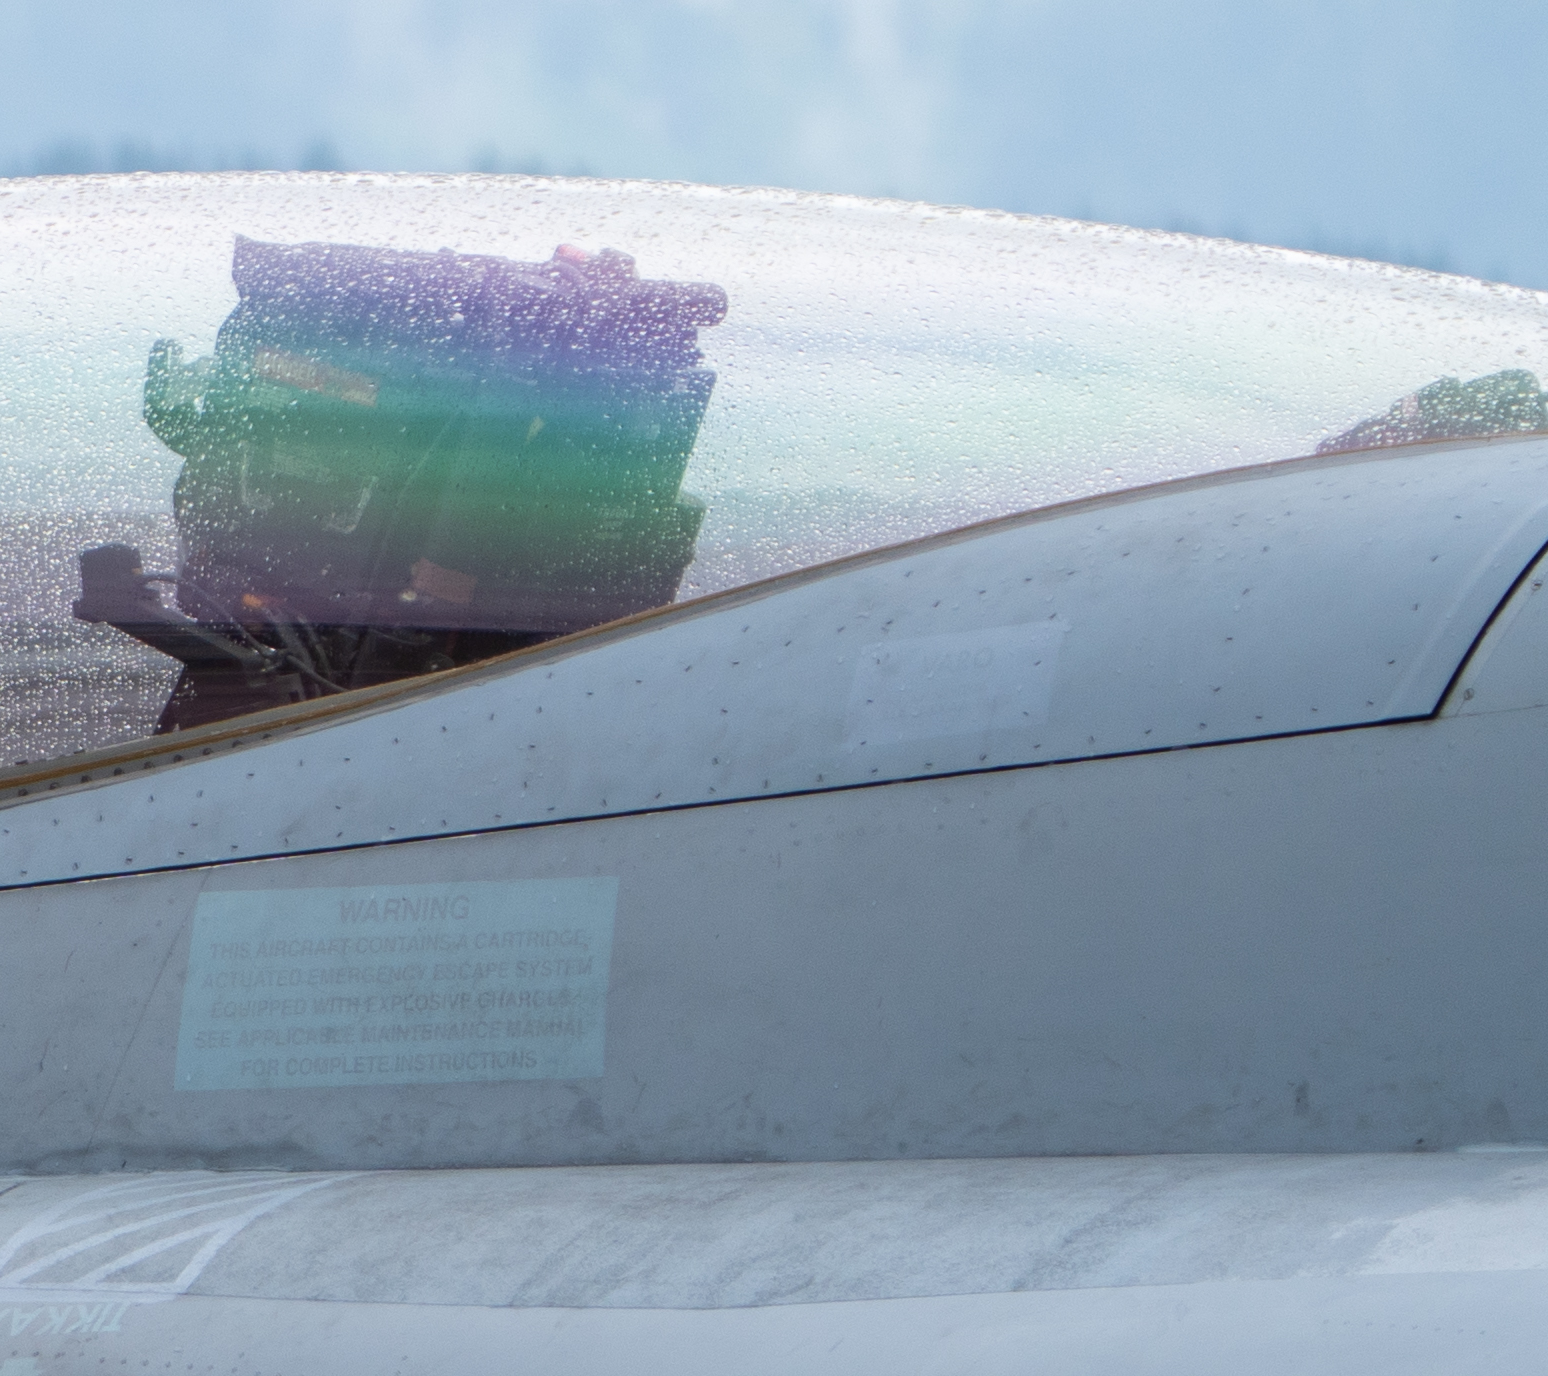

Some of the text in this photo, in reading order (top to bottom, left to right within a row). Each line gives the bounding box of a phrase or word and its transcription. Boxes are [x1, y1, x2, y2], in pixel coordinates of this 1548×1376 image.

[339, 895, 470, 923] WARNING
[210, 942, 251, 960] THIS
[255, 937, 351, 957] AIRCRAFT
[356, 934, 449, 953] CONTAINS
[202, 957, 594, 989] ACTUATED EMERGENCY ESCAPE SYSTEM
[210, 997, 306, 1019] EQUIPPED
[312, 995, 357, 1015] WITH
[194, 1030, 232, 1050] SEE
[241, 1050, 537, 1077] FOR COMPLETE INSTRUCTIONS
